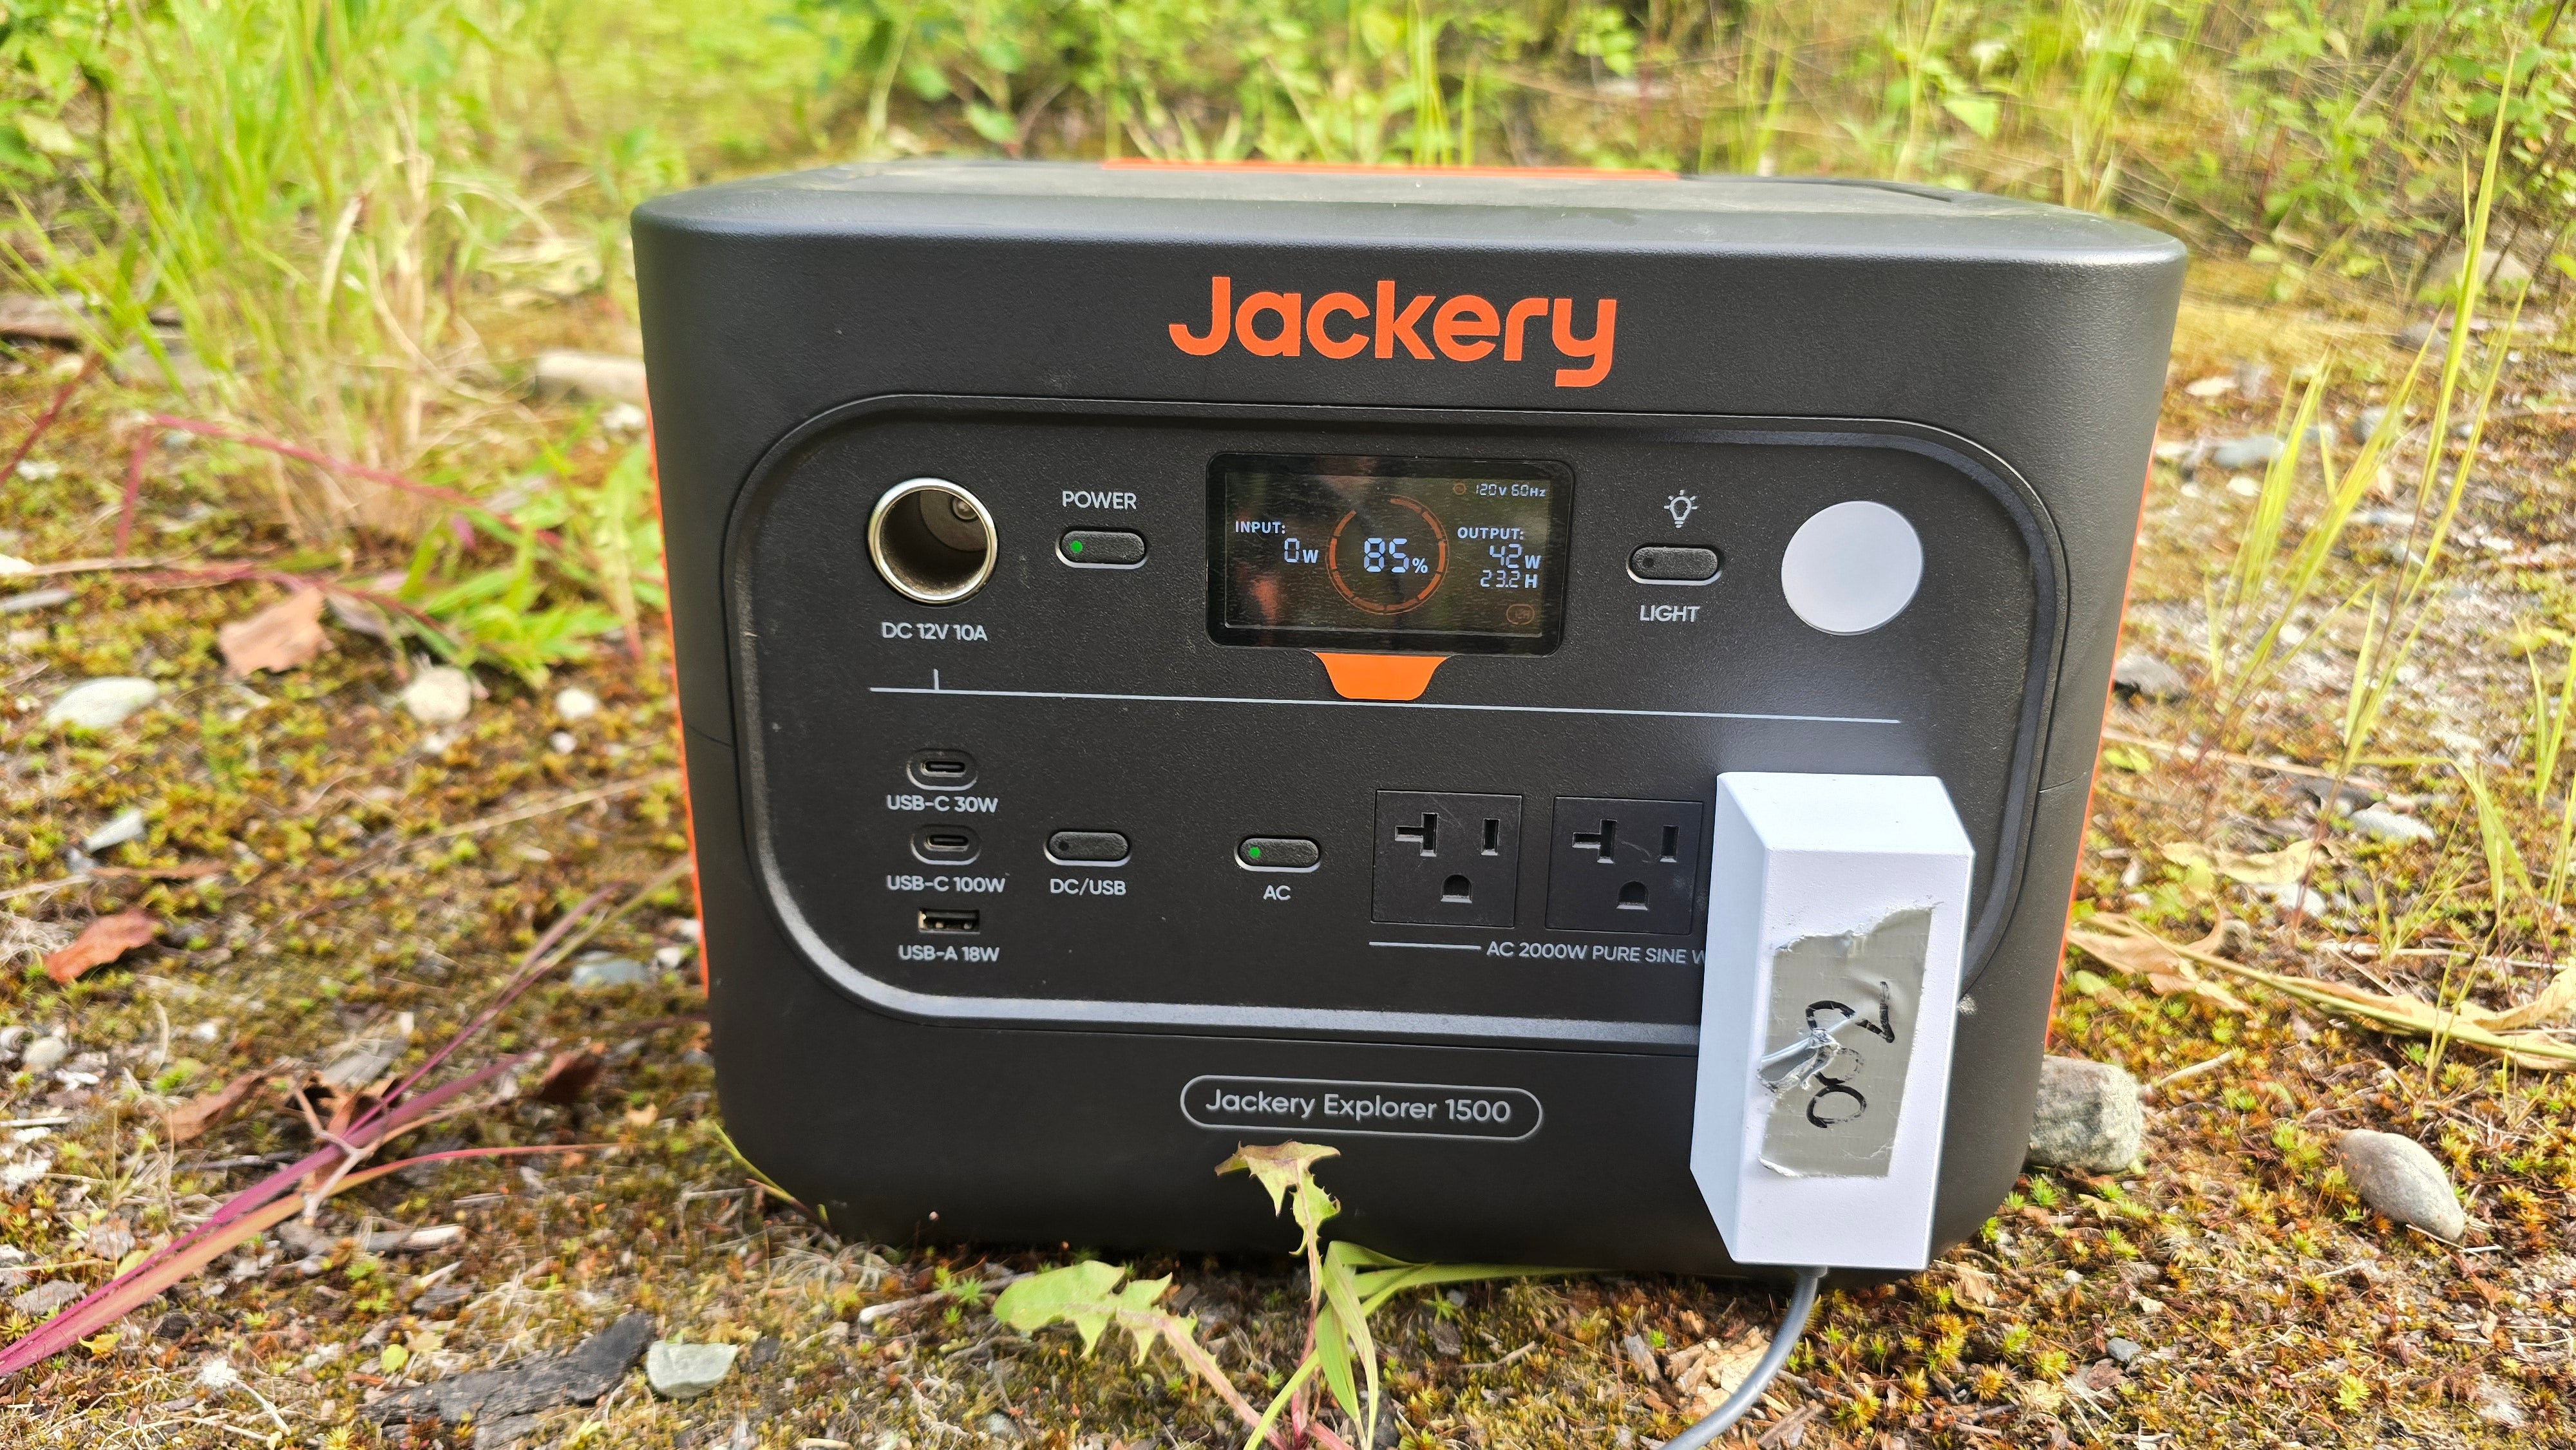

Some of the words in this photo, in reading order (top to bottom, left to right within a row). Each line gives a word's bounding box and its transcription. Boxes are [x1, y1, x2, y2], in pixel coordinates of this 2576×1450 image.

[1168, 276, 1618, 388] Jackery
[1062, 491, 1137, 510] POWER
[1235, 521, 1285, 534] INPUT:
[1457, 527, 1524, 540] OUTPUT:
[1640, 605, 1700, 623] LIGHT
[881, 621, 913, 639] DC
[917, 623, 949, 640] 12V
[954, 625, 988, 641] 10A
[886, 795, 950, 812] USB-C
[954, 796, 998, 813] 30W
[886, 875, 949, 892] USB-C
[955, 876, 1005, 894] 100W
[1050, 878, 1126, 896] DC/USB
[1263, 885, 1291, 901] AC
[898, 945, 958, 961] USB-A
[962, 946, 999, 963] 18W
[1486, 941, 1513, 957] AC
[1519, 942, 1586, 960] 2000W
[1593, 946, 1641, 963] PURE
[1645, 948, 1687, 964] SINE
[1206, 1089, 1315, 1118] Jackery
[1323, 1094, 1436, 1120] Explorer
[1445, 1099, 1511, 1122] 1500
